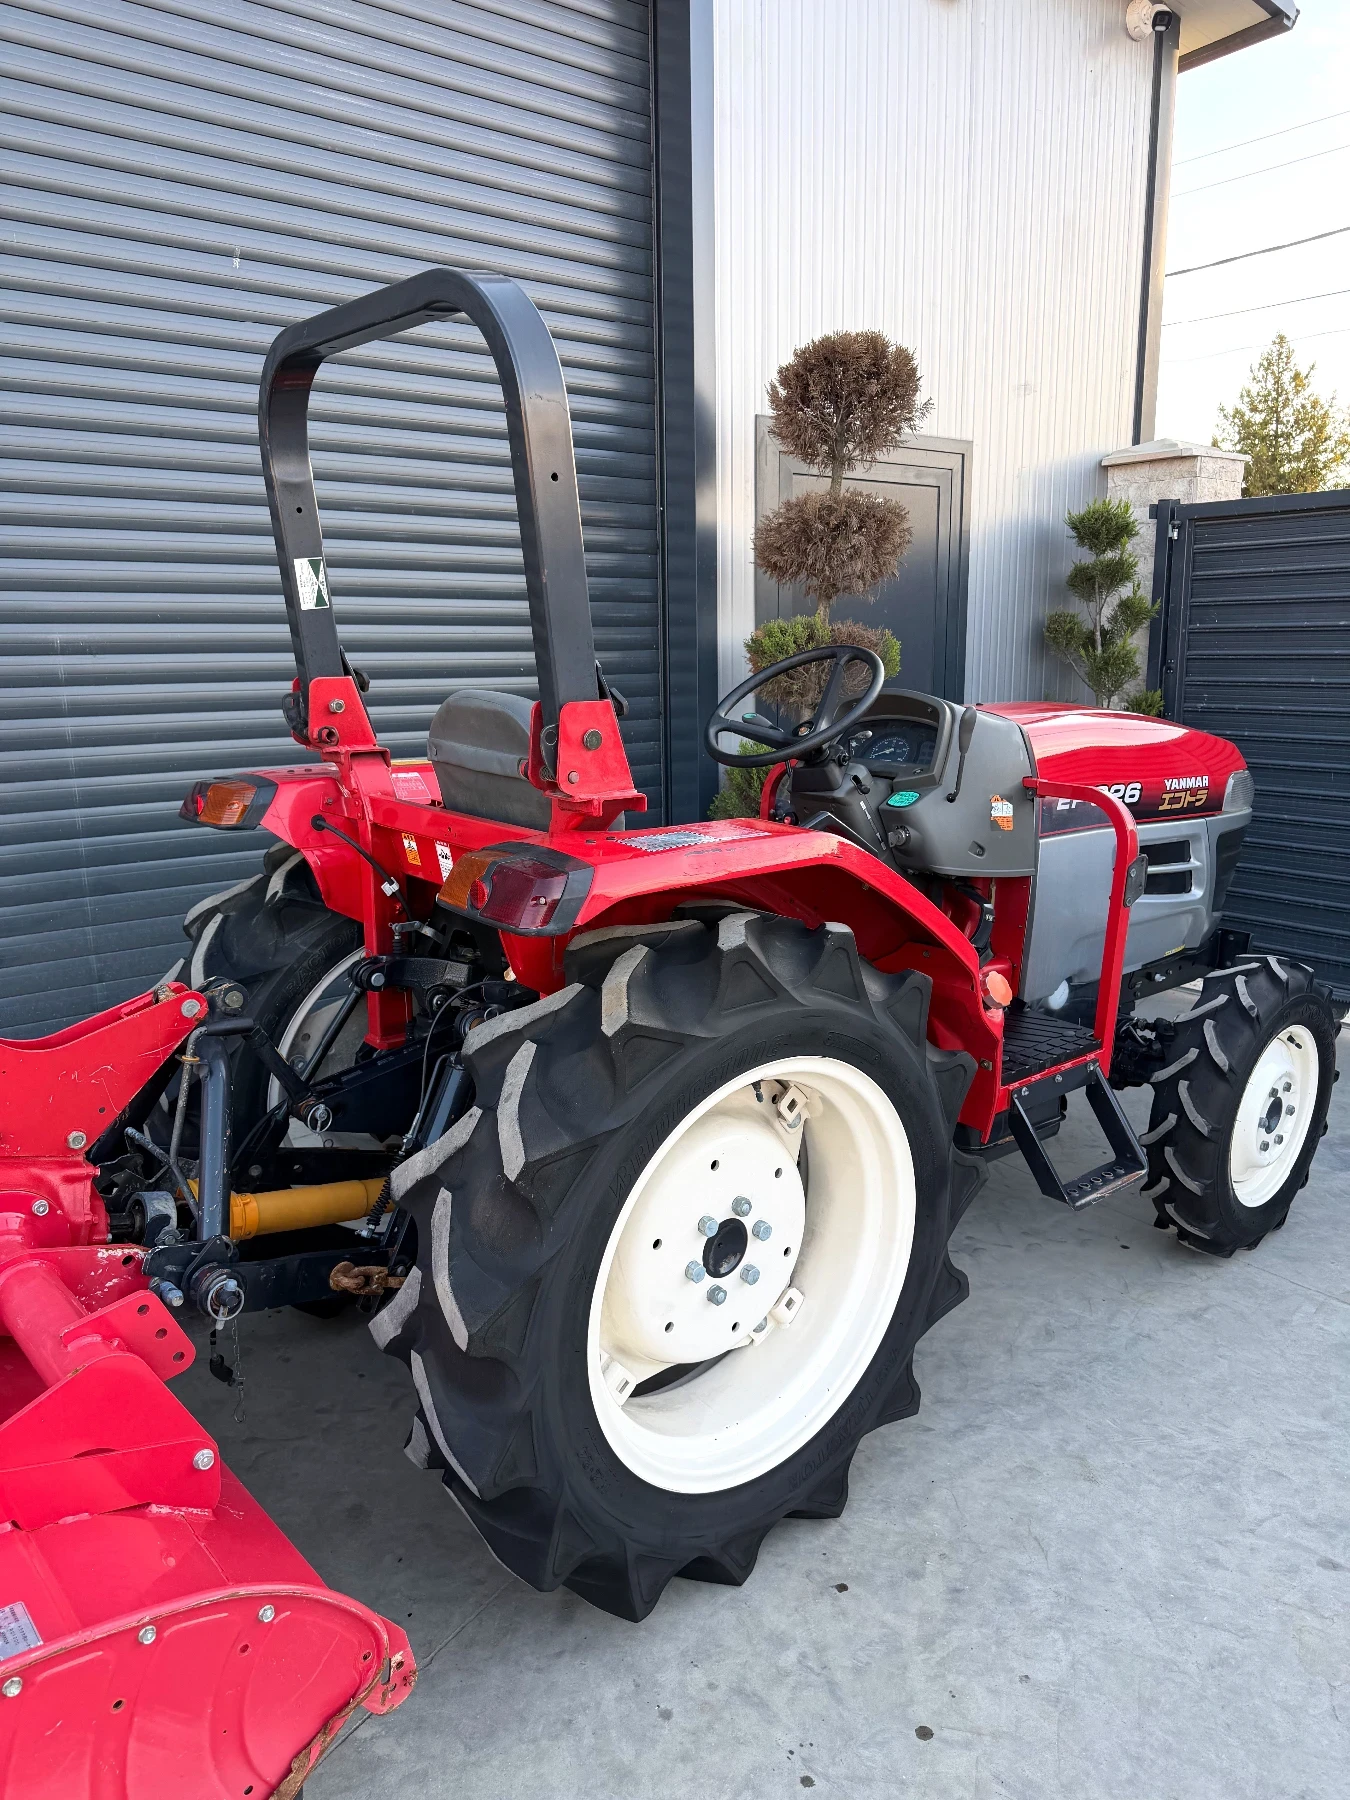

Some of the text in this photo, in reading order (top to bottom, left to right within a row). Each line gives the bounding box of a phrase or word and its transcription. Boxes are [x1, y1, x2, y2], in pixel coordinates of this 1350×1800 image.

[1164, 775, 1209, 790] YANMAR
[1158, 789, 1209, 811] エコトラ
